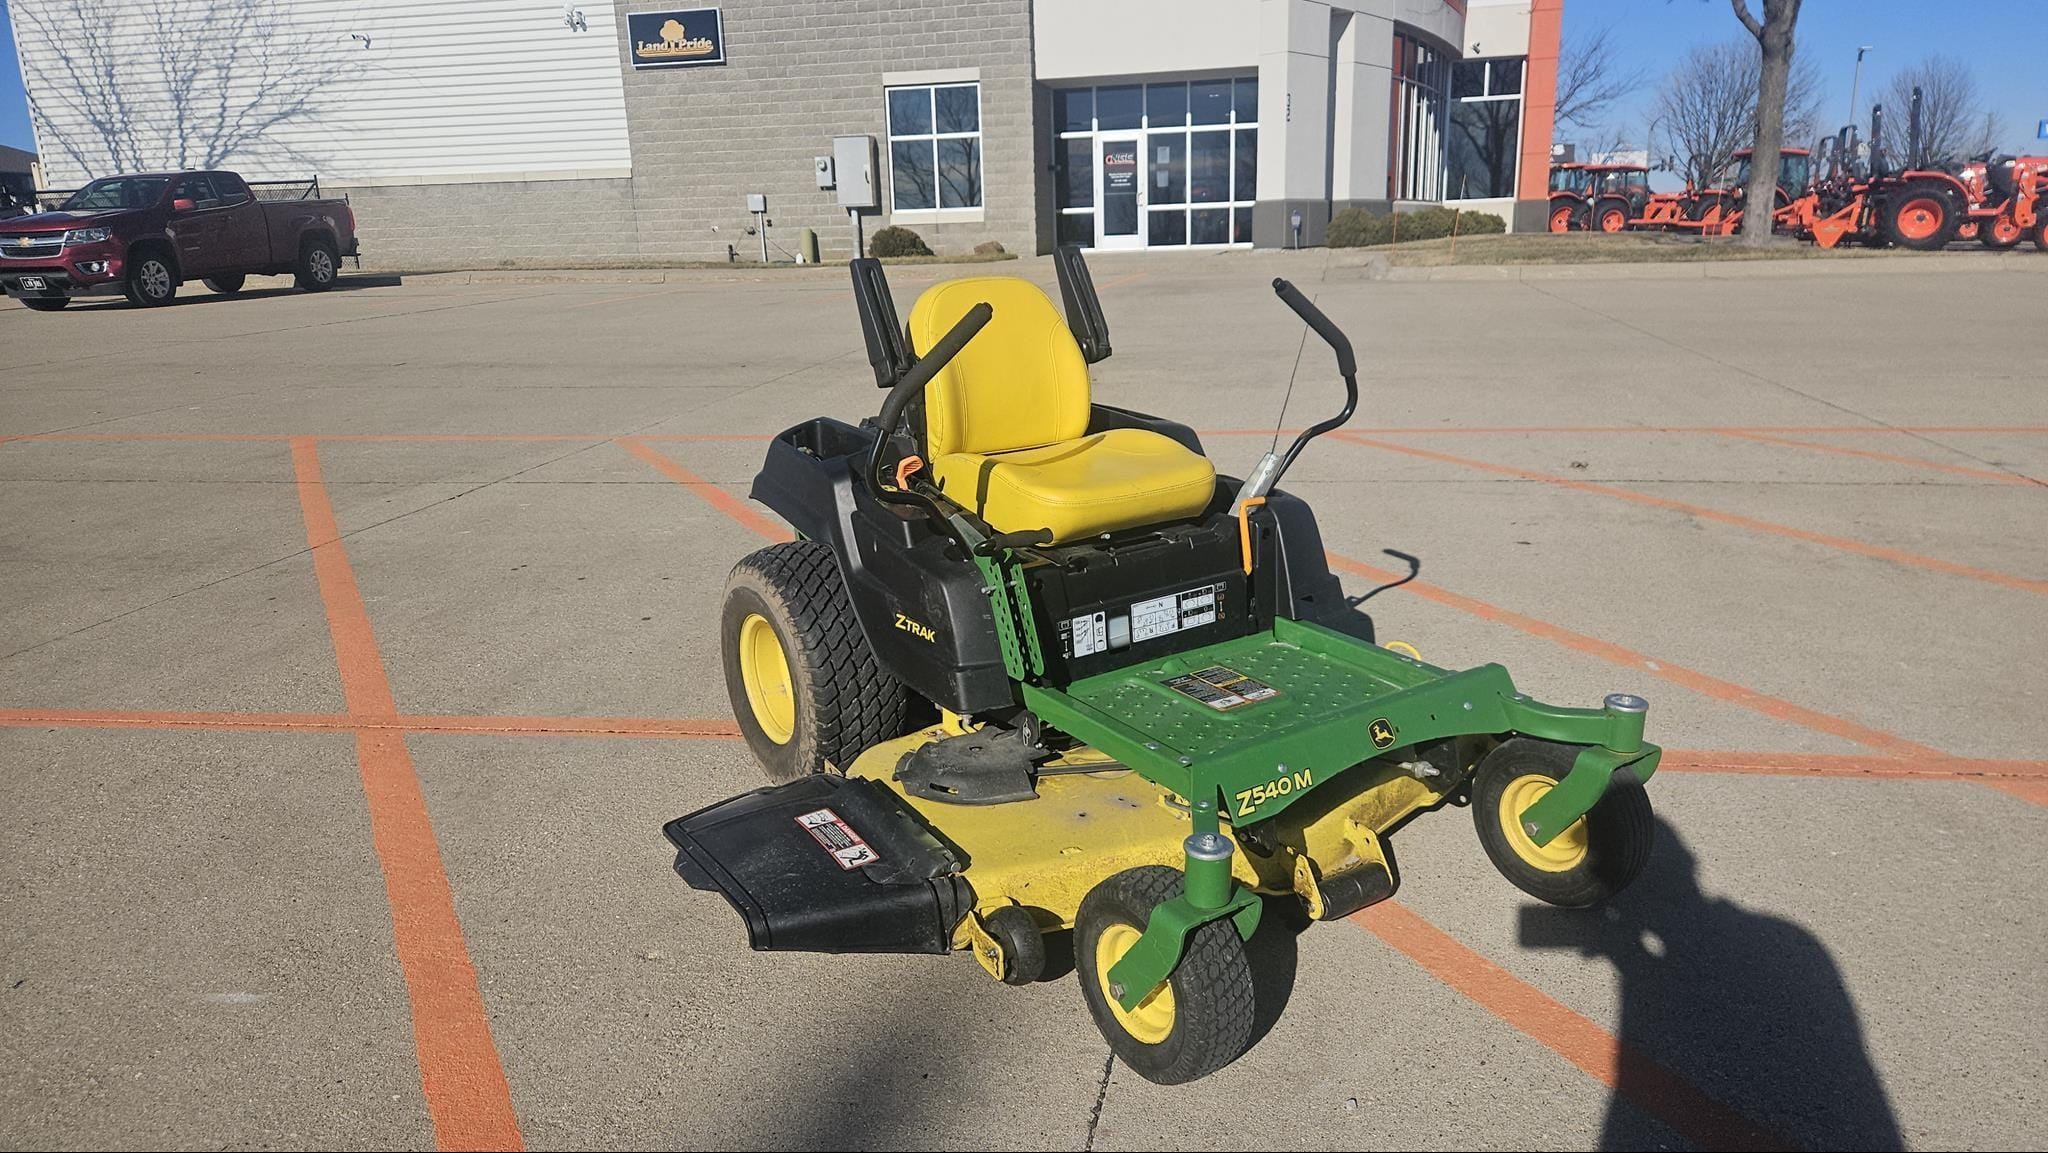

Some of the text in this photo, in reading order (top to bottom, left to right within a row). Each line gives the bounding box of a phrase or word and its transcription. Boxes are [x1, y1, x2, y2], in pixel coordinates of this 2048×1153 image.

[637, 37, 713, 52] Land Pride
[895, 613, 936, 643] ZTRAK
[1236, 769, 1313, 817] Z540 M
